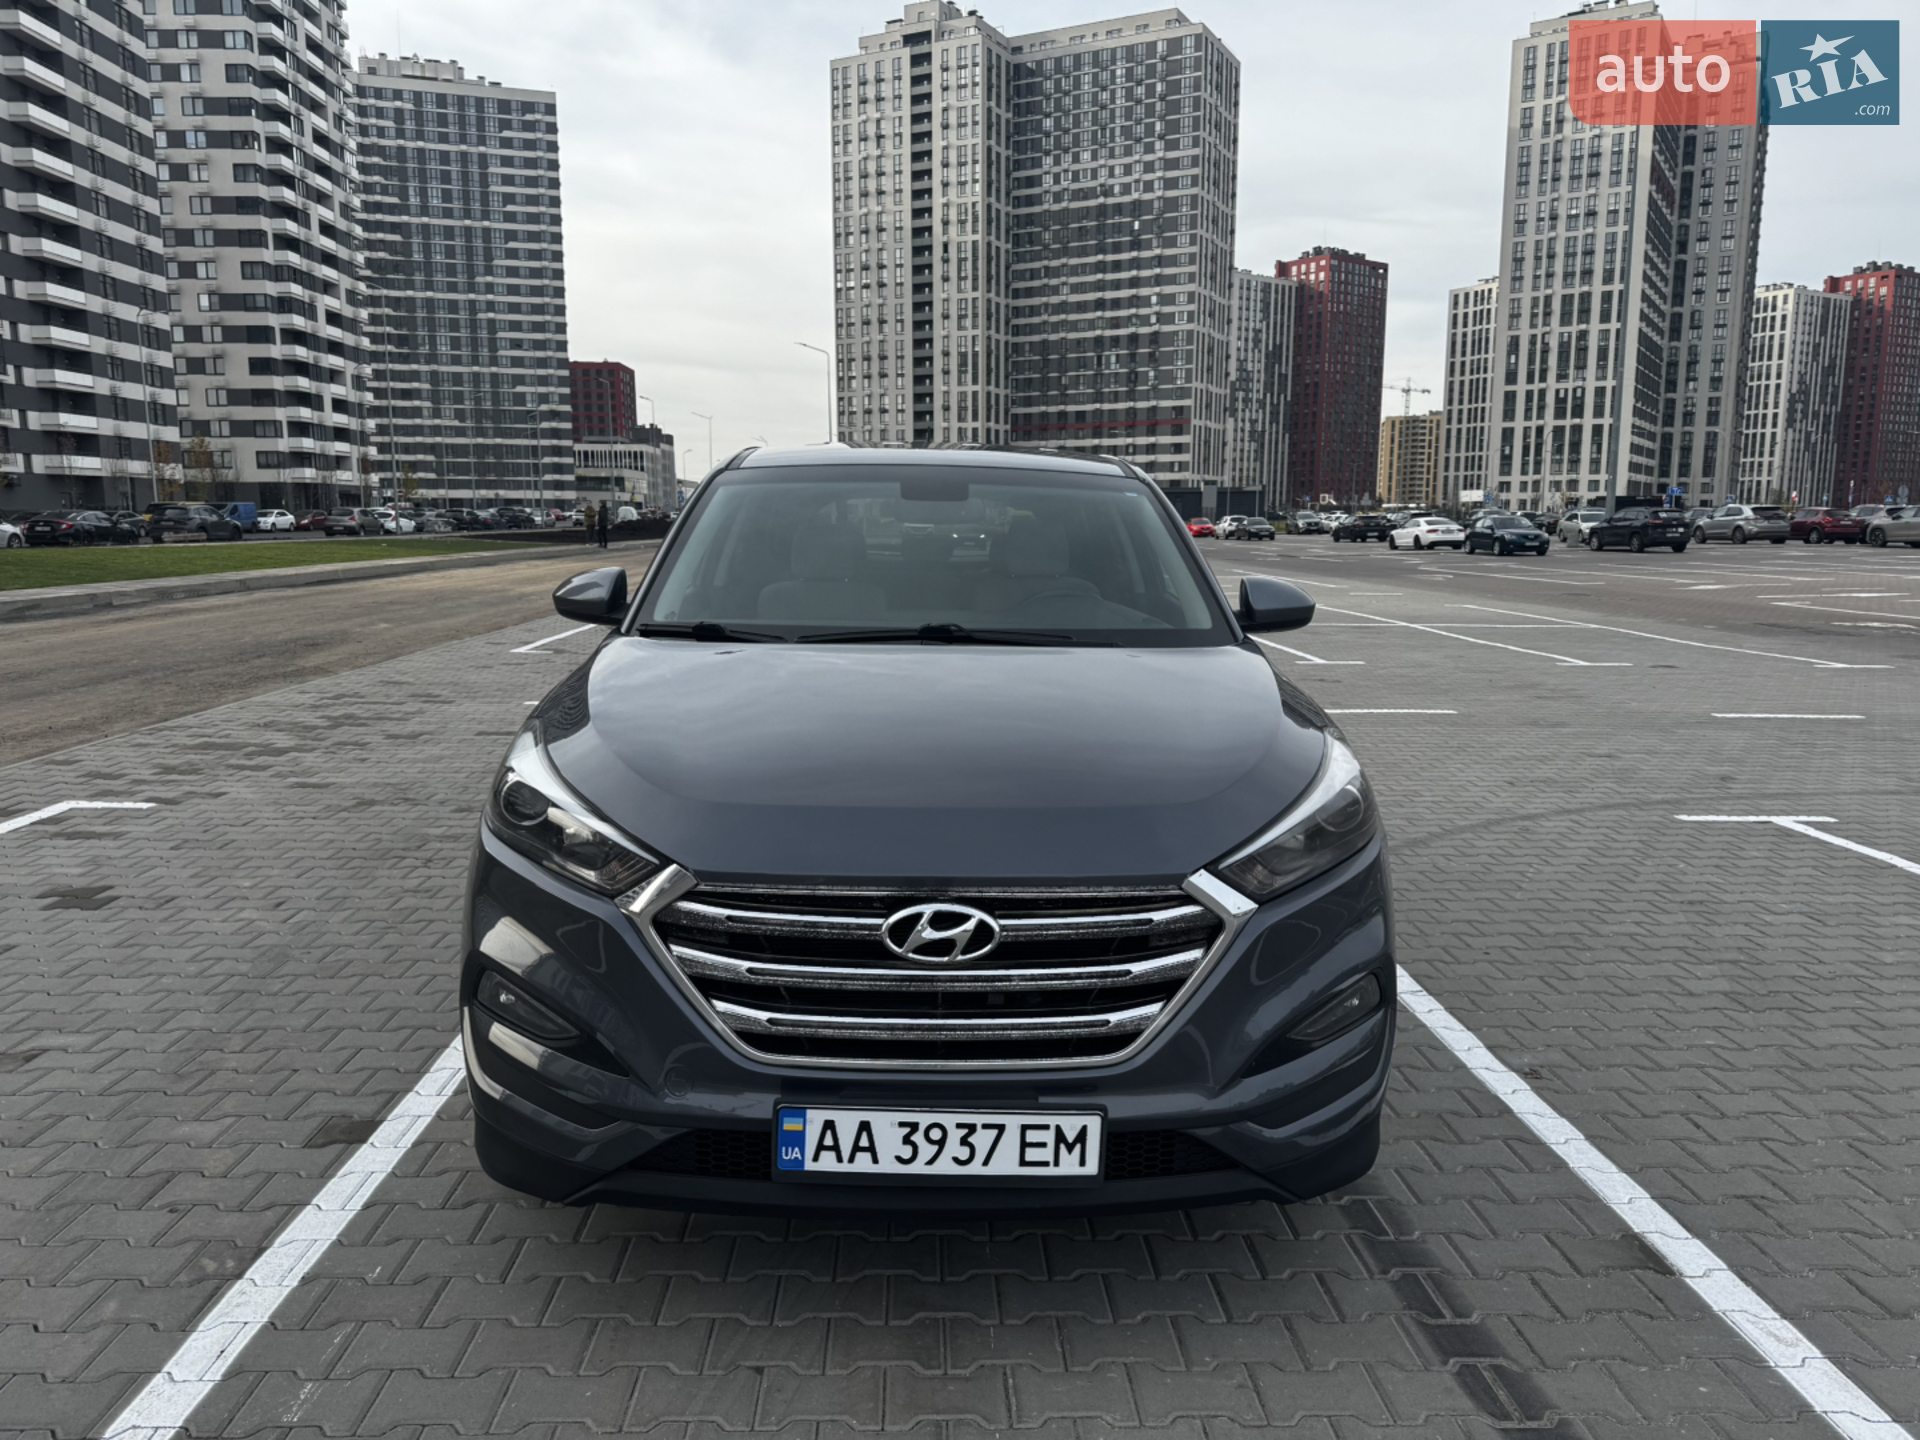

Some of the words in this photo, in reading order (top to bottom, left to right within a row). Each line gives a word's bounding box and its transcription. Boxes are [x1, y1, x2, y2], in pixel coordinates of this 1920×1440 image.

[782, 1146, 802, 1161] UA
[811, 1119, 879, 1165] AA
[894, 1121, 1006, 1167] 3937
[1018, 1123, 1088, 1167] EM
